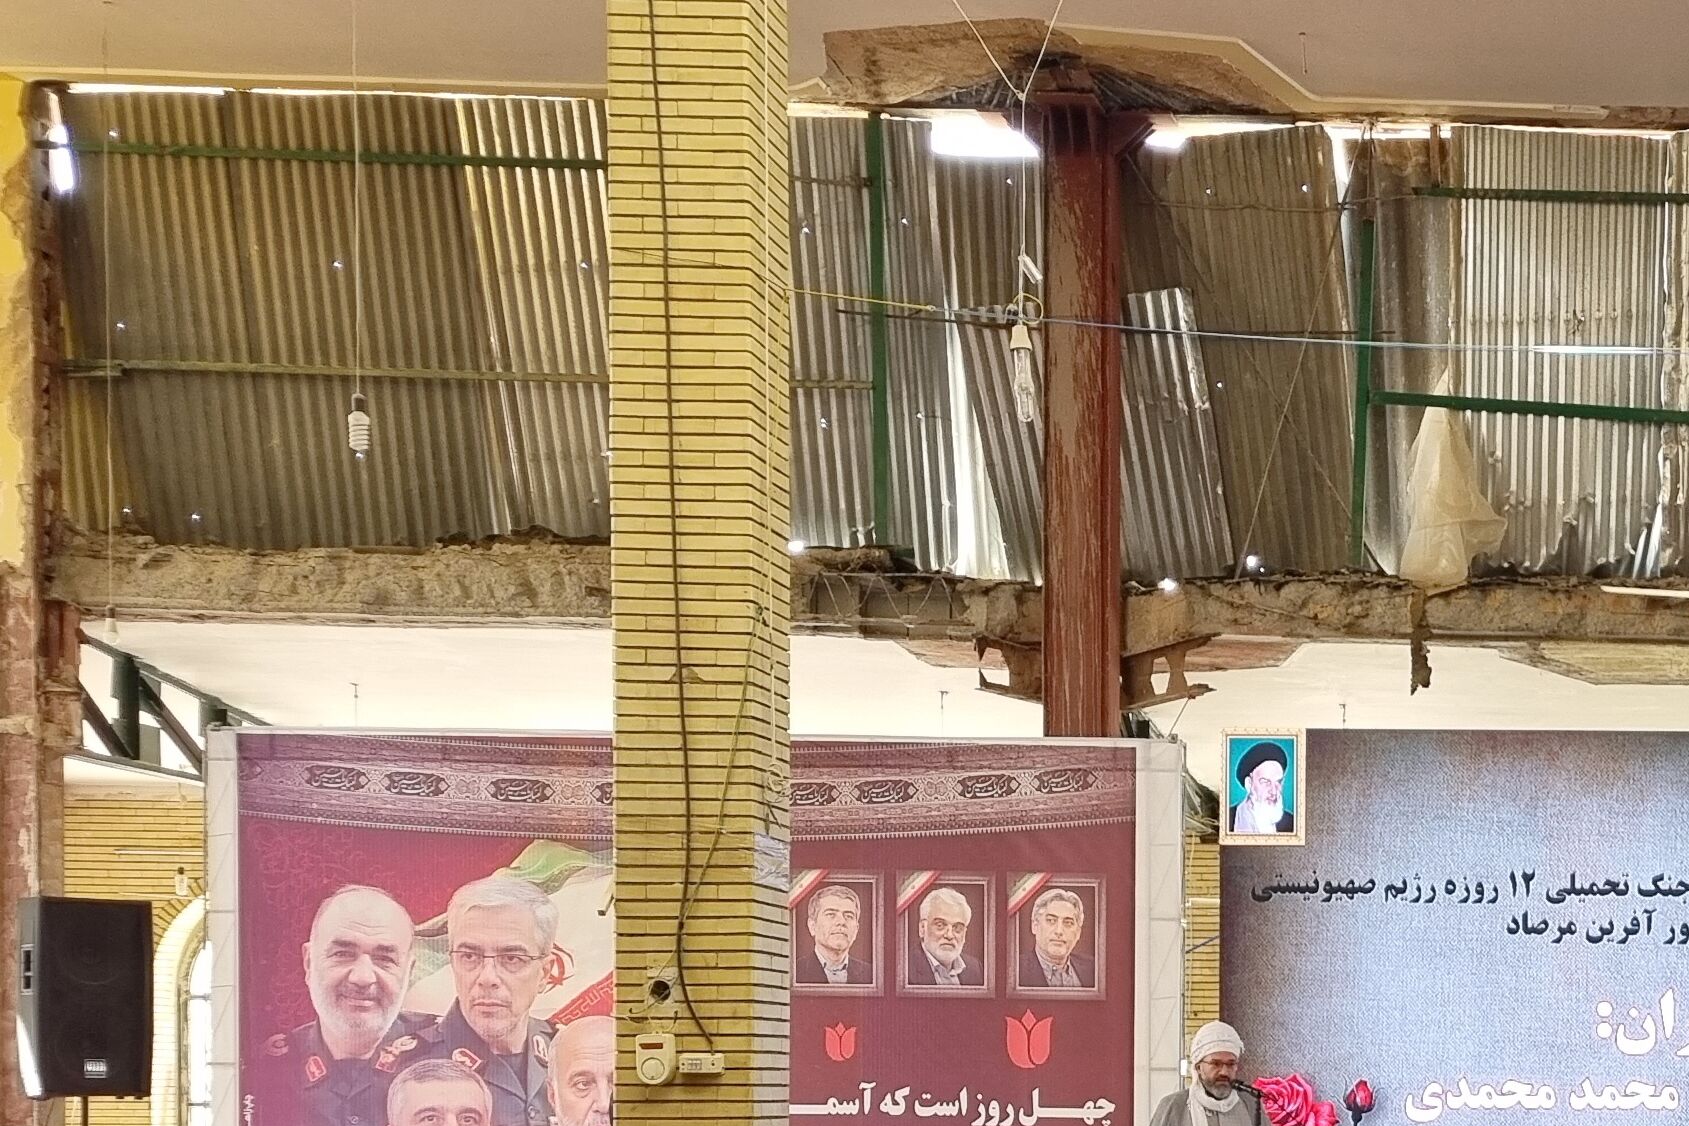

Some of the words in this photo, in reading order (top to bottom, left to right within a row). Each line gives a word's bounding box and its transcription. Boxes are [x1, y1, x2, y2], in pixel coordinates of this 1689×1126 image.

[1250, 868, 1377, 903] صهیونیستی
[1384, 872, 1437, 904] رژیم
[1445, 876, 1499, 904] روزه
[1509, 869, 1536, 898] ۱۲
[1545, 871, 1631, 905] تحمیلی
[1506, 911, 1577, 944] مرصاد
[1585, 907, 1657, 945] آفرین
[789, 1081, 876, 1116] آسم
[879, 1085, 910, 1117] که
[914, 1086, 967, 1117] است
[971, 1092, 1015, 1126] روز
[1404, 1074, 1557, 1123] محمدی
[1569, 1074, 1680, 1112] محمد
